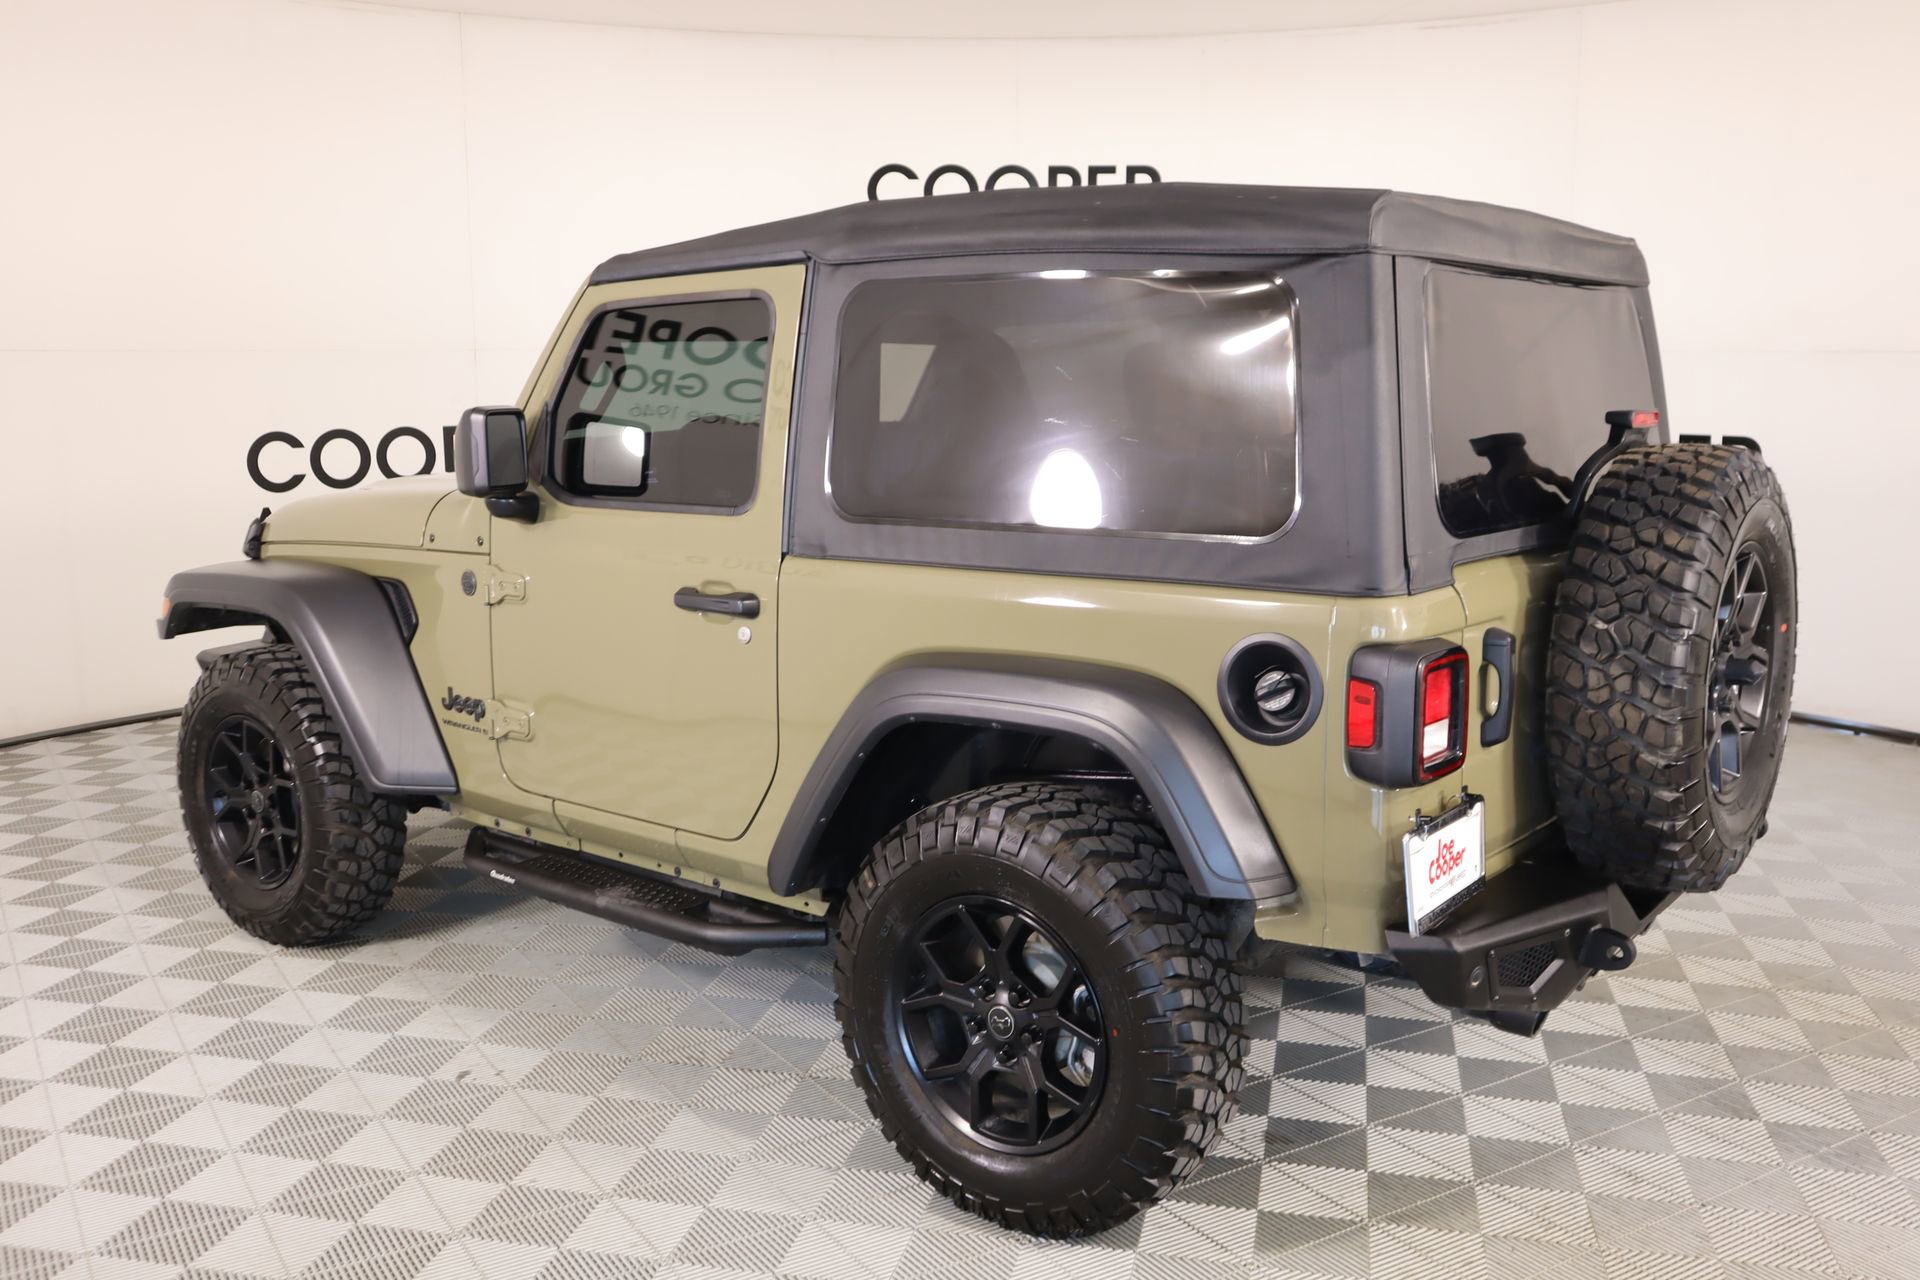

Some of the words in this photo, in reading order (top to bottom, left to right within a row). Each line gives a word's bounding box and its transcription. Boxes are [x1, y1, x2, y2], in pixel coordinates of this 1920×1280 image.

[441, 686, 486, 722] Jeep
[1429, 847, 1466, 884] Cooper
[1436, 839, 1455, 864] Joe
